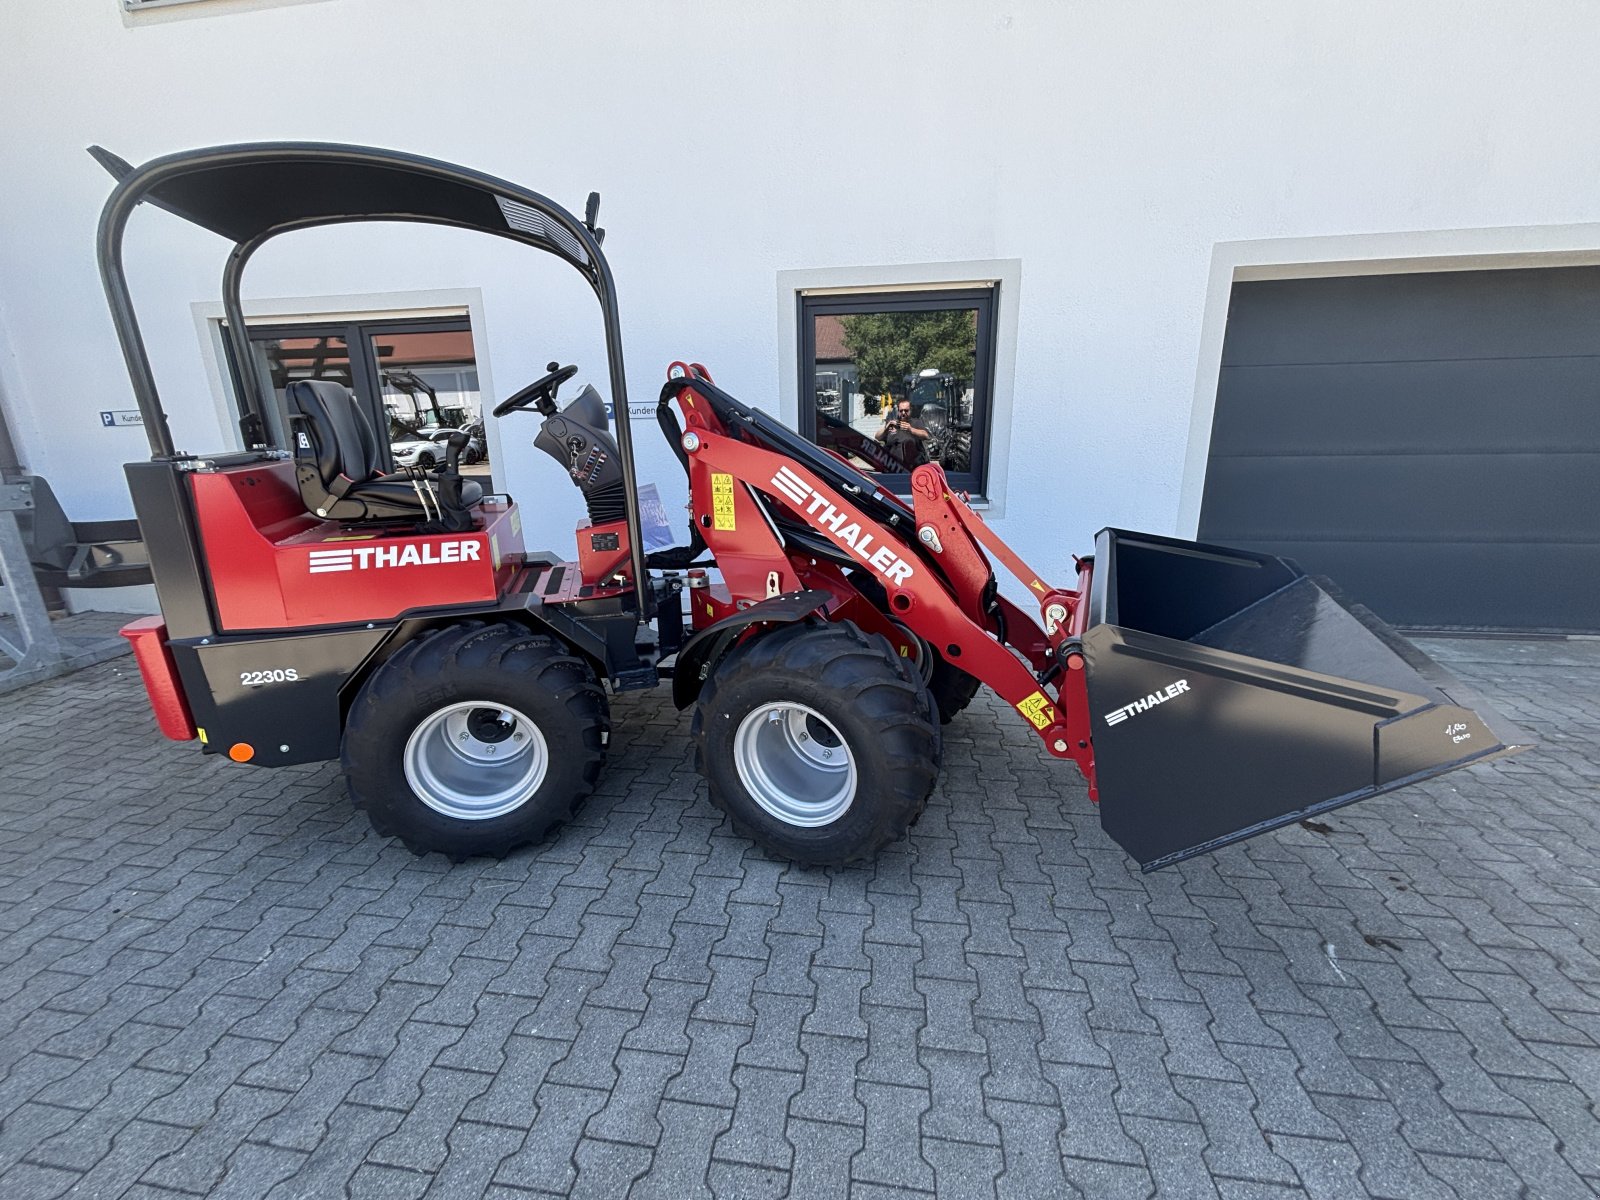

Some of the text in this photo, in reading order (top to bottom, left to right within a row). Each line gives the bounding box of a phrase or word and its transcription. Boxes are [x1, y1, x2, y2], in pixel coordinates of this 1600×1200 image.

[102, 413, 143, 425] P Kunde
[628, 406, 656, 415] Kunden
[806, 490, 914, 587] THALER
[352, 540, 481, 570] THALER
[240, 668, 299, 685] 2230S
[1123, 679, 1191, 717] THALER
